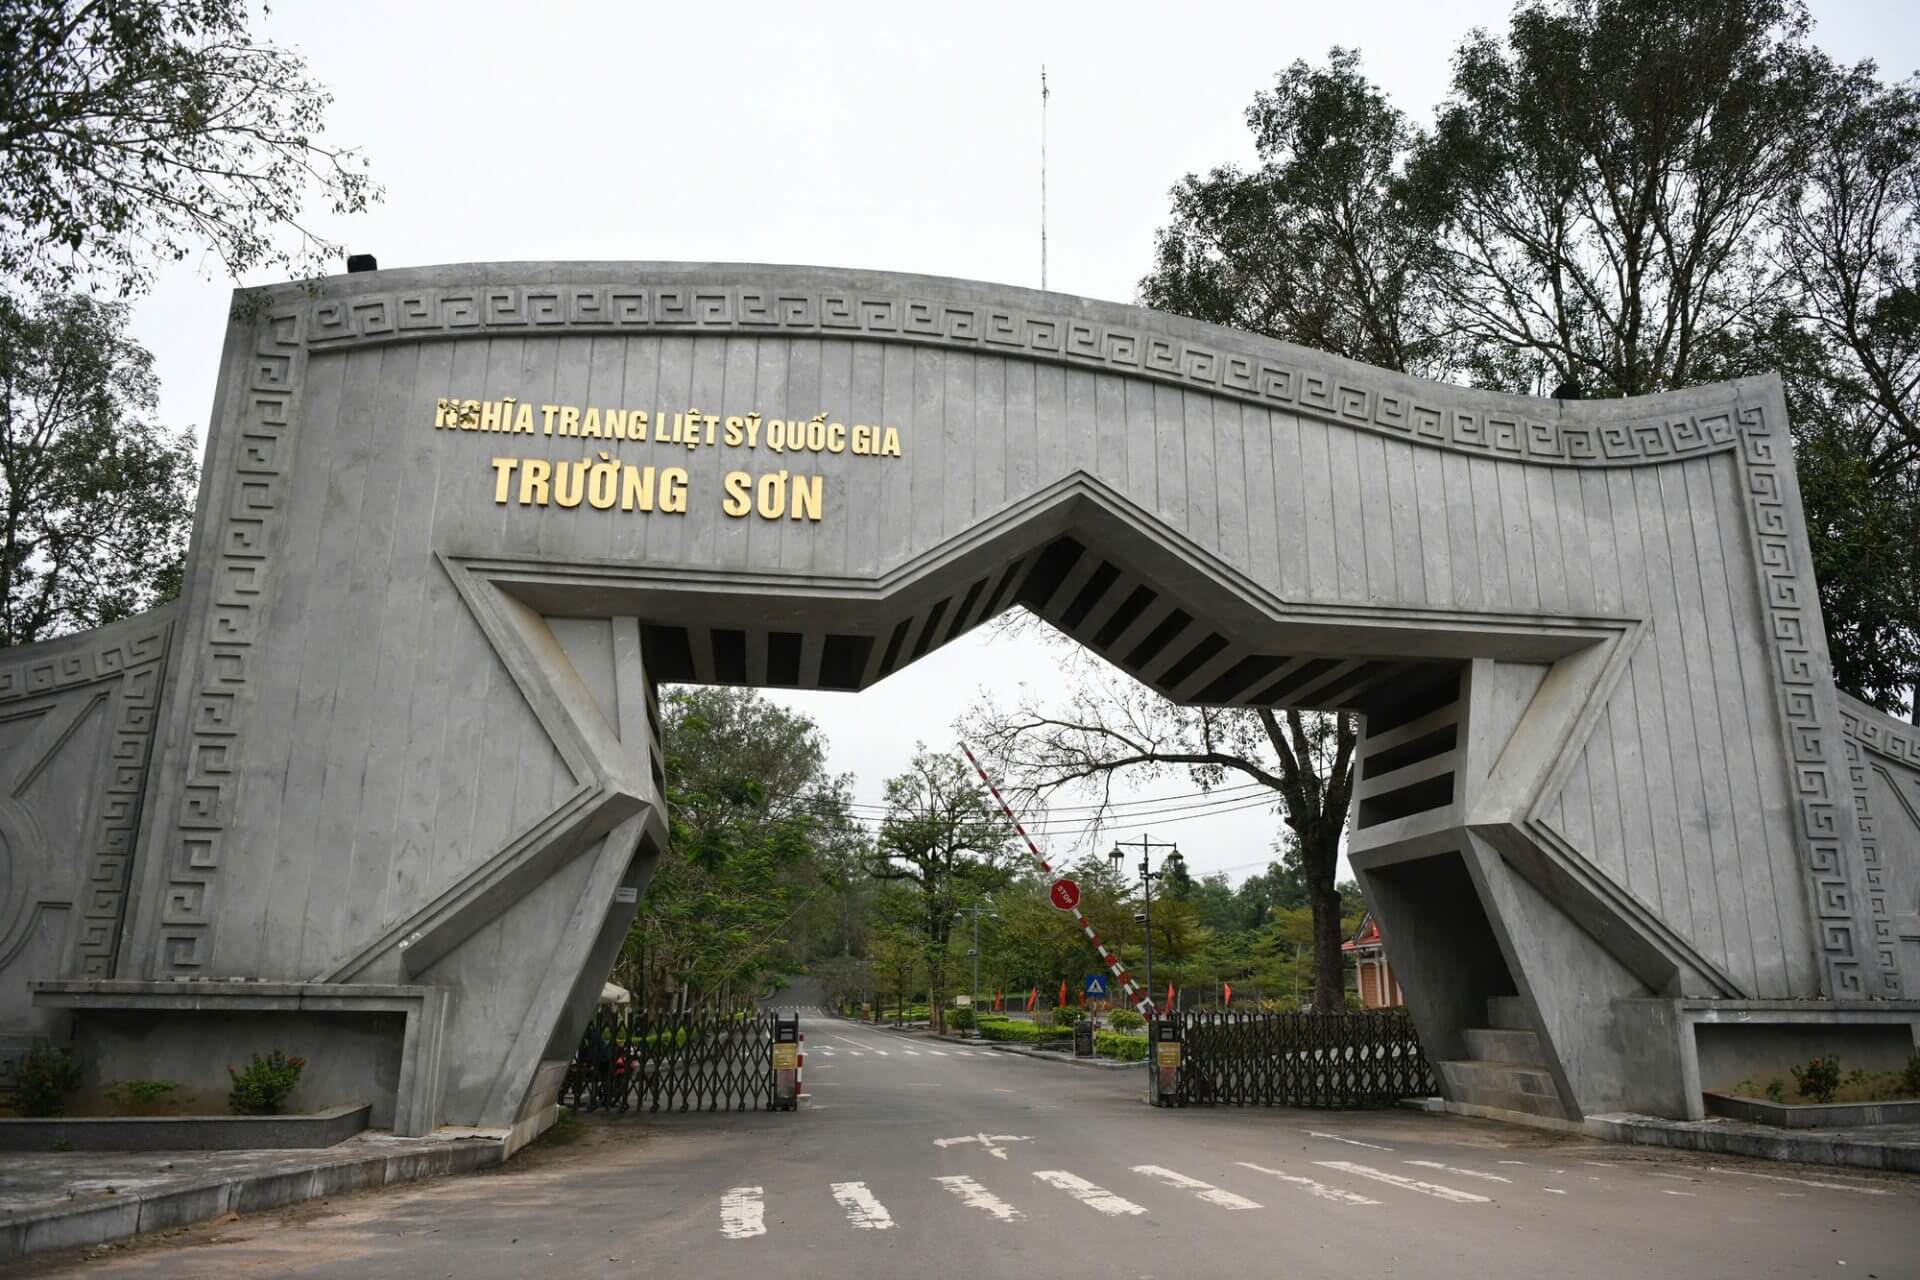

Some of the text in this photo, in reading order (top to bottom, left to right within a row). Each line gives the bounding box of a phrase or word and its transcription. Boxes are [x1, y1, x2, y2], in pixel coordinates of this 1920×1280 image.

[435, 397, 902, 457] NGHĨA TRANG LIỆT SỸ QUỐC GIA
[491, 451, 824, 521] TRƯỜNG SƠN
